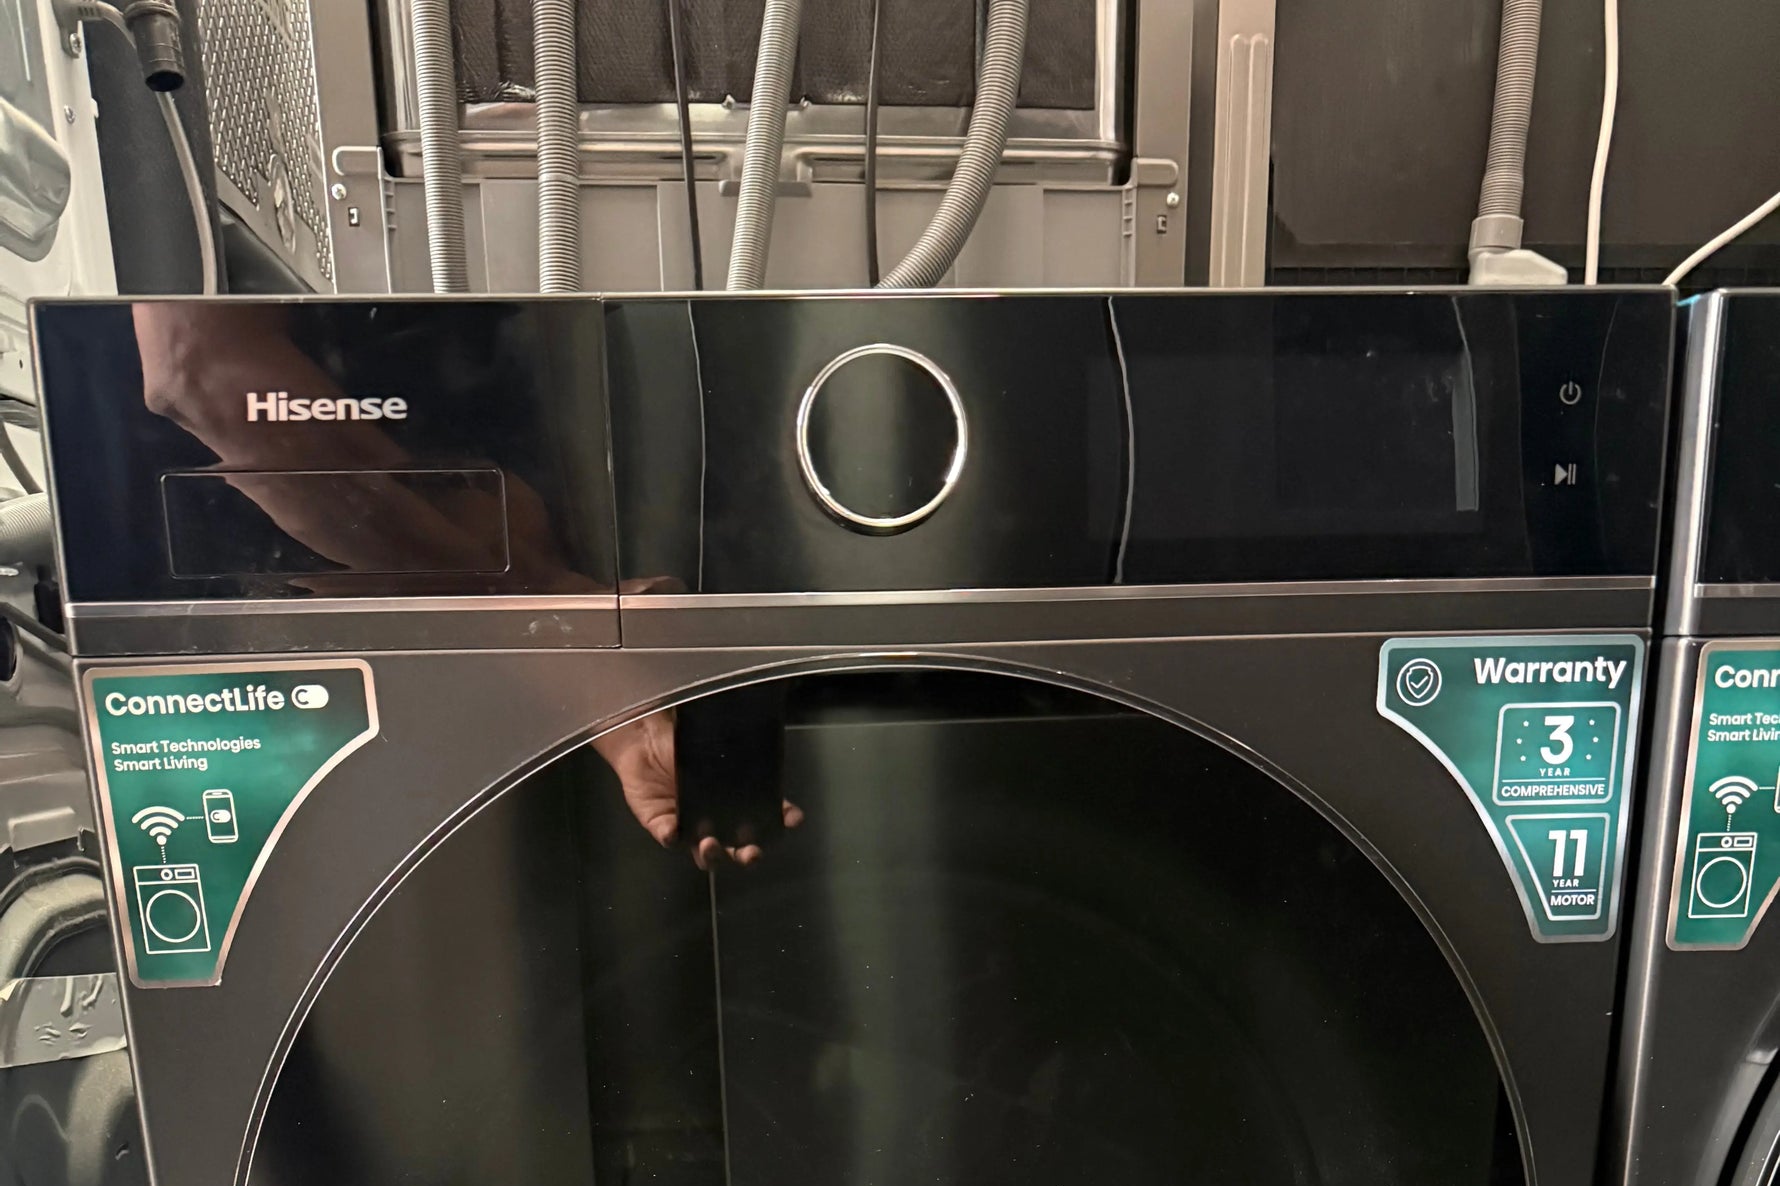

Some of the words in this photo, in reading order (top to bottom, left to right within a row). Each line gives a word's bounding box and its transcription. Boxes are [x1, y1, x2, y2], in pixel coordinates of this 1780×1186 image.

[246, 391, 408, 422] Hisense
[1473, 656, 1627, 689] Warranty
[105, 684, 285, 716] ConnectLife
[1708, 712, 1753, 726] Smart
[1754, 712, 1780, 725] Tec
[1540, 715, 1575, 765] 3
[1707, 728, 1752, 742] Smart
[111, 740, 159, 755] Smart
[160, 736, 261, 754] Technologies
[114, 758, 162, 772] Smart
[163, 755, 208, 771] Living
[1539, 767, 1571, 777] YEAR
[1501, 783, 1605, 798] COMPREHENSIVE
[1548, 829, 1588, 878] 11
[1552, 878, 1580, 888] YEAR
[1550, 894, 1595, 907] MOTOR
